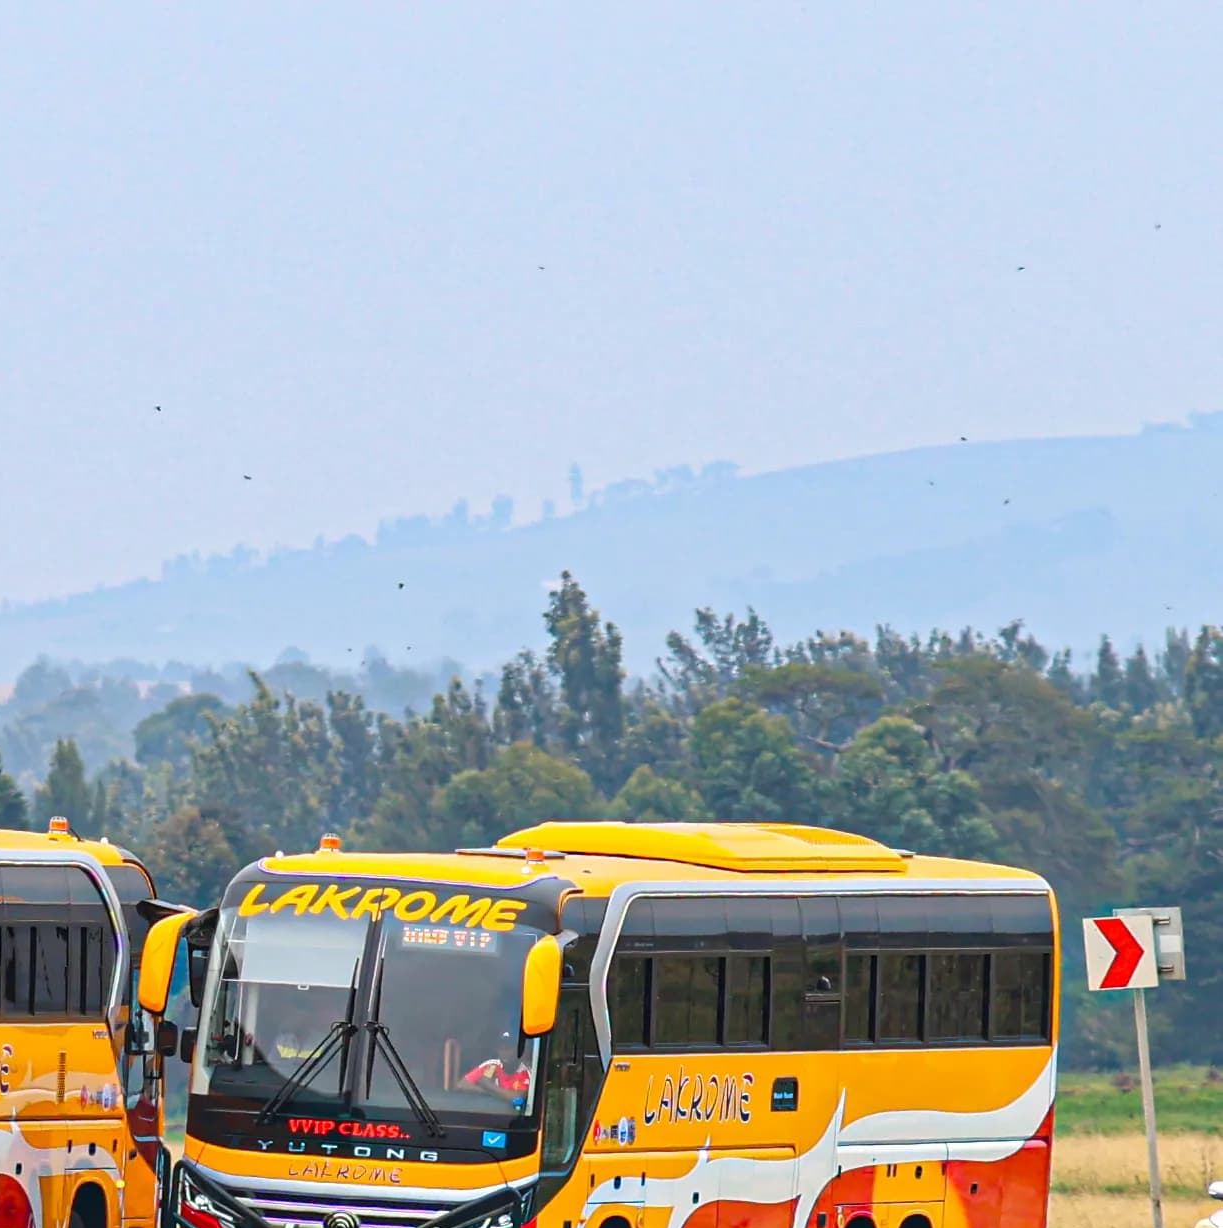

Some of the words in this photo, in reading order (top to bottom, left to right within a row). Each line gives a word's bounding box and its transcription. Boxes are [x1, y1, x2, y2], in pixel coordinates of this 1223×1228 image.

[237, 884, 527, 932] LAKROME
[643, 1064, 754, 1125] LAKROME
[288, 1118, 336, 1136] VVIP
[257, 1139, 438, 1162] YUTONG
[288, 1157, 404, 1184] LAKROME
